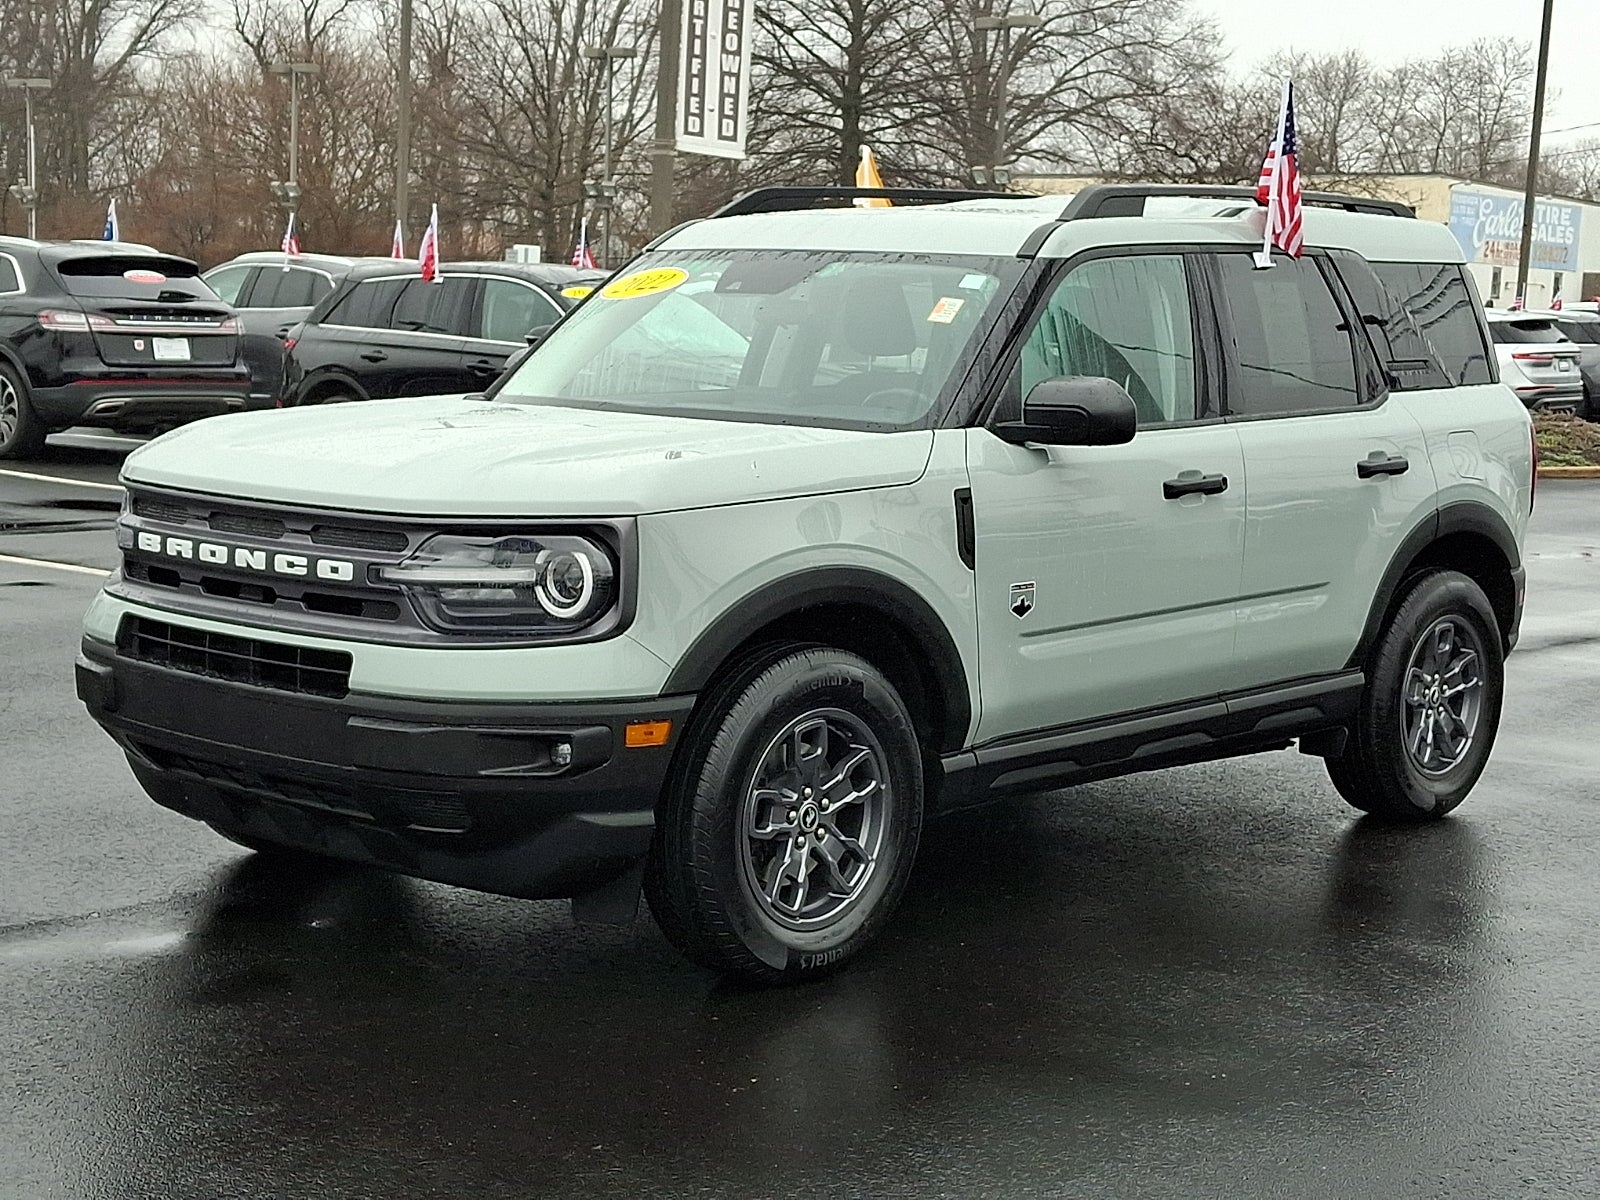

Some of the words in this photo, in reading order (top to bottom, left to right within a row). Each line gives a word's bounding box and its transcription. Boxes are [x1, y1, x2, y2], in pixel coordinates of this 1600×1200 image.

[1535, 204, 1572, 226] TIRE
[1531, 222, 1575, 245] SALES
[137, 531, 354, 581] BRONCO
